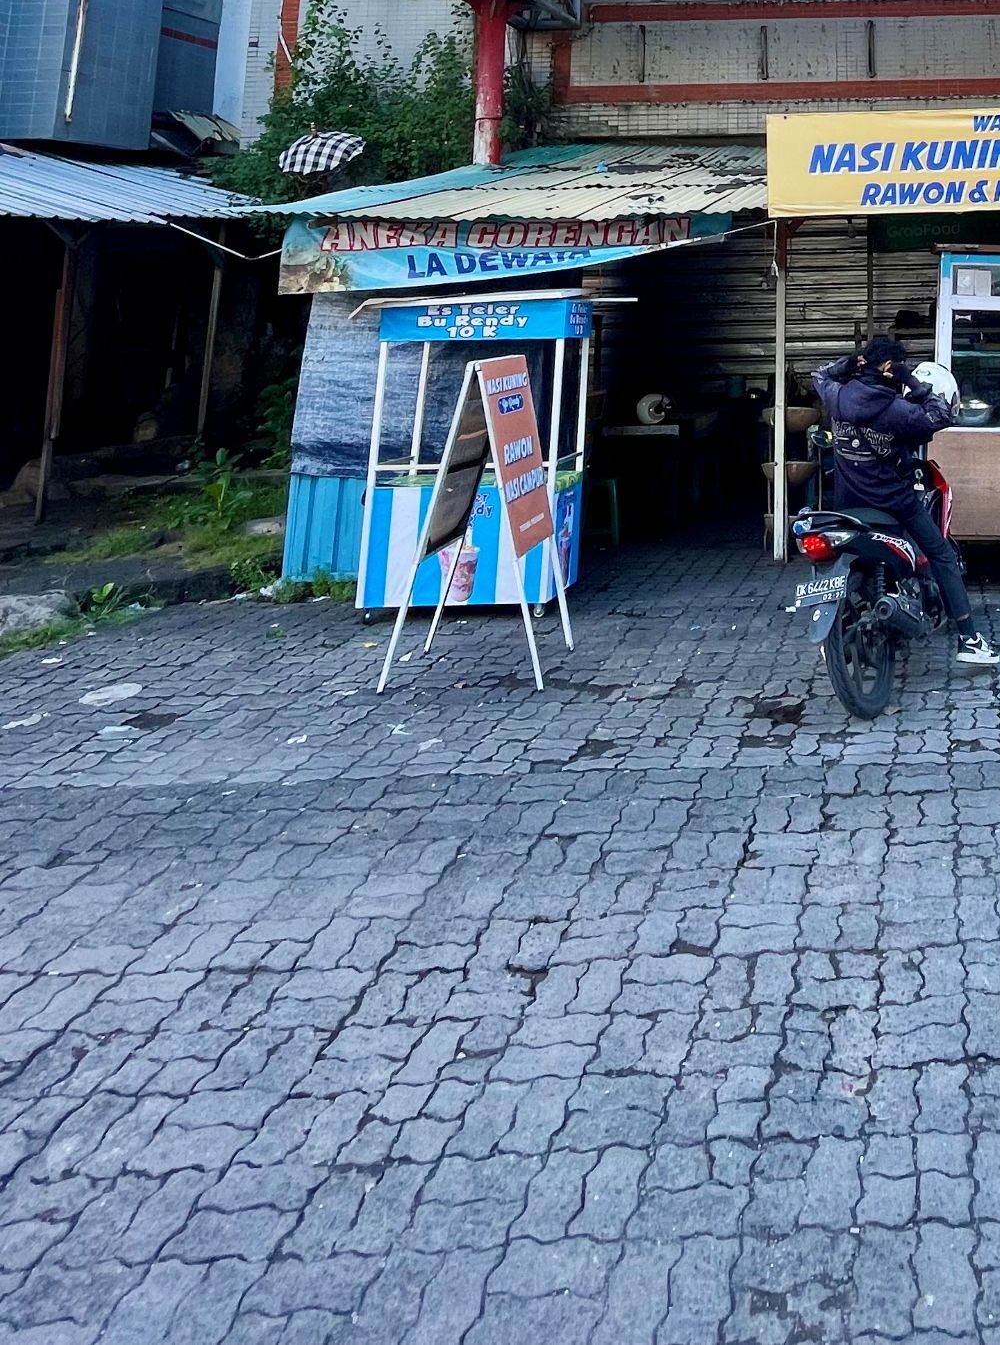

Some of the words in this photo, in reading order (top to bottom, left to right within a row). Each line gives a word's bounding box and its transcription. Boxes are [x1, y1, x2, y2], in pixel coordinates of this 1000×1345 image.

[808, 141, 896, 174] NASI
[860, 180, 967, 207] RAWON
[968, 179, 988, 203] &
[320, 221, 457, 252] ANEKA
[465, 217, 691, 248] GORENGAN
[407, 252, 448, 279] LA
[416, 315, 447, 327] Bu
[455, 314, 528, 328] Rendy
[427, 304, 451, 316] Es
[459, 303, 520, 316] Teler
[446, 326, 475, 338] 10
[482, 326, 498, 338] K
[503, 435, 533, 466] RAWON
[796, 583, 807, 597] DK
[807, 579, 829, 594] 6442
[829, 575, 846, 589] KBE
